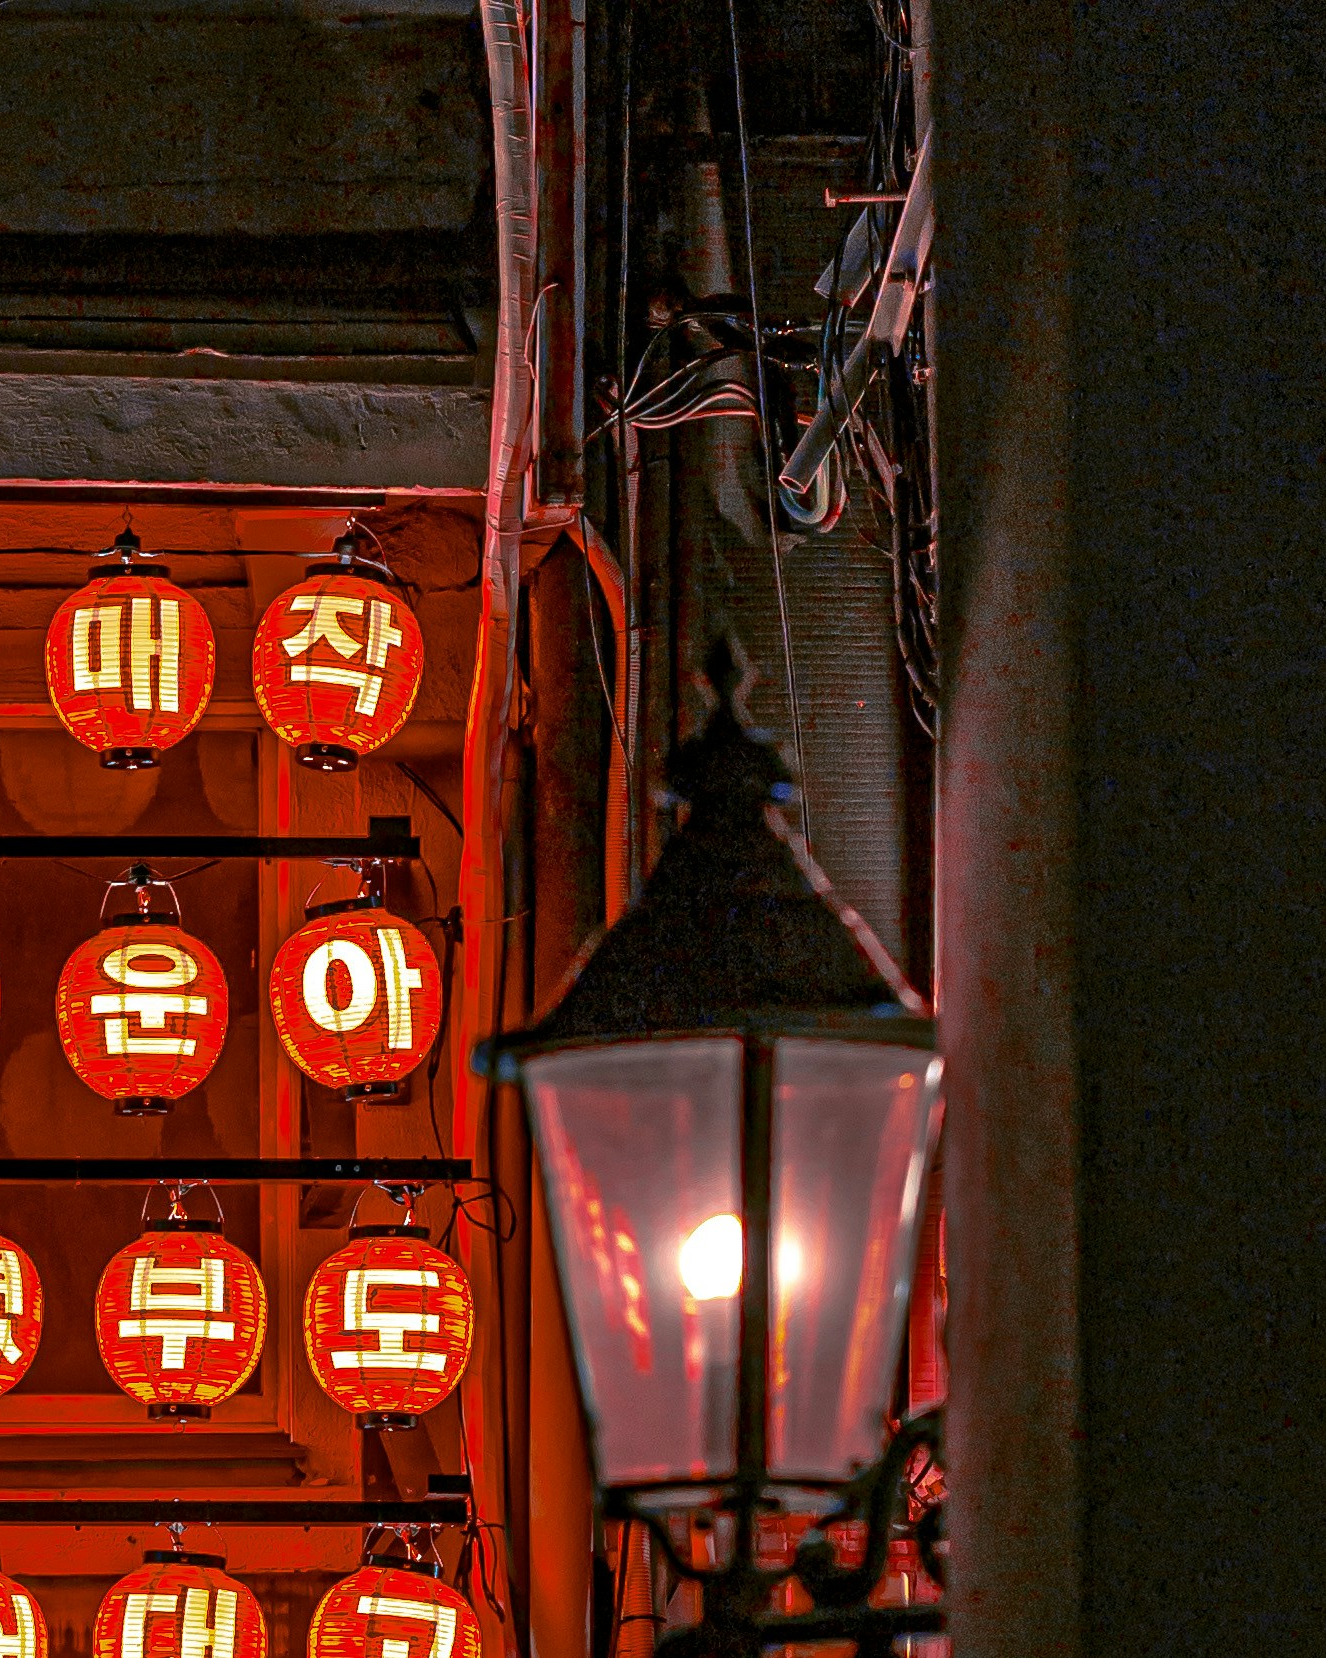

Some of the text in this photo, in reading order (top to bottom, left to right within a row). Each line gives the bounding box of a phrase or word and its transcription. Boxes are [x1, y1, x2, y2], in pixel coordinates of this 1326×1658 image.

[73, 599, 178, 712] 매
[282, 596, 401, 716] 작
[91, 946, 207, 1055] 운
[303, 929, 421, 1048] 아
[119, 1258, 234, 1369] 부
[331, 1270, 446, 1371] 도
